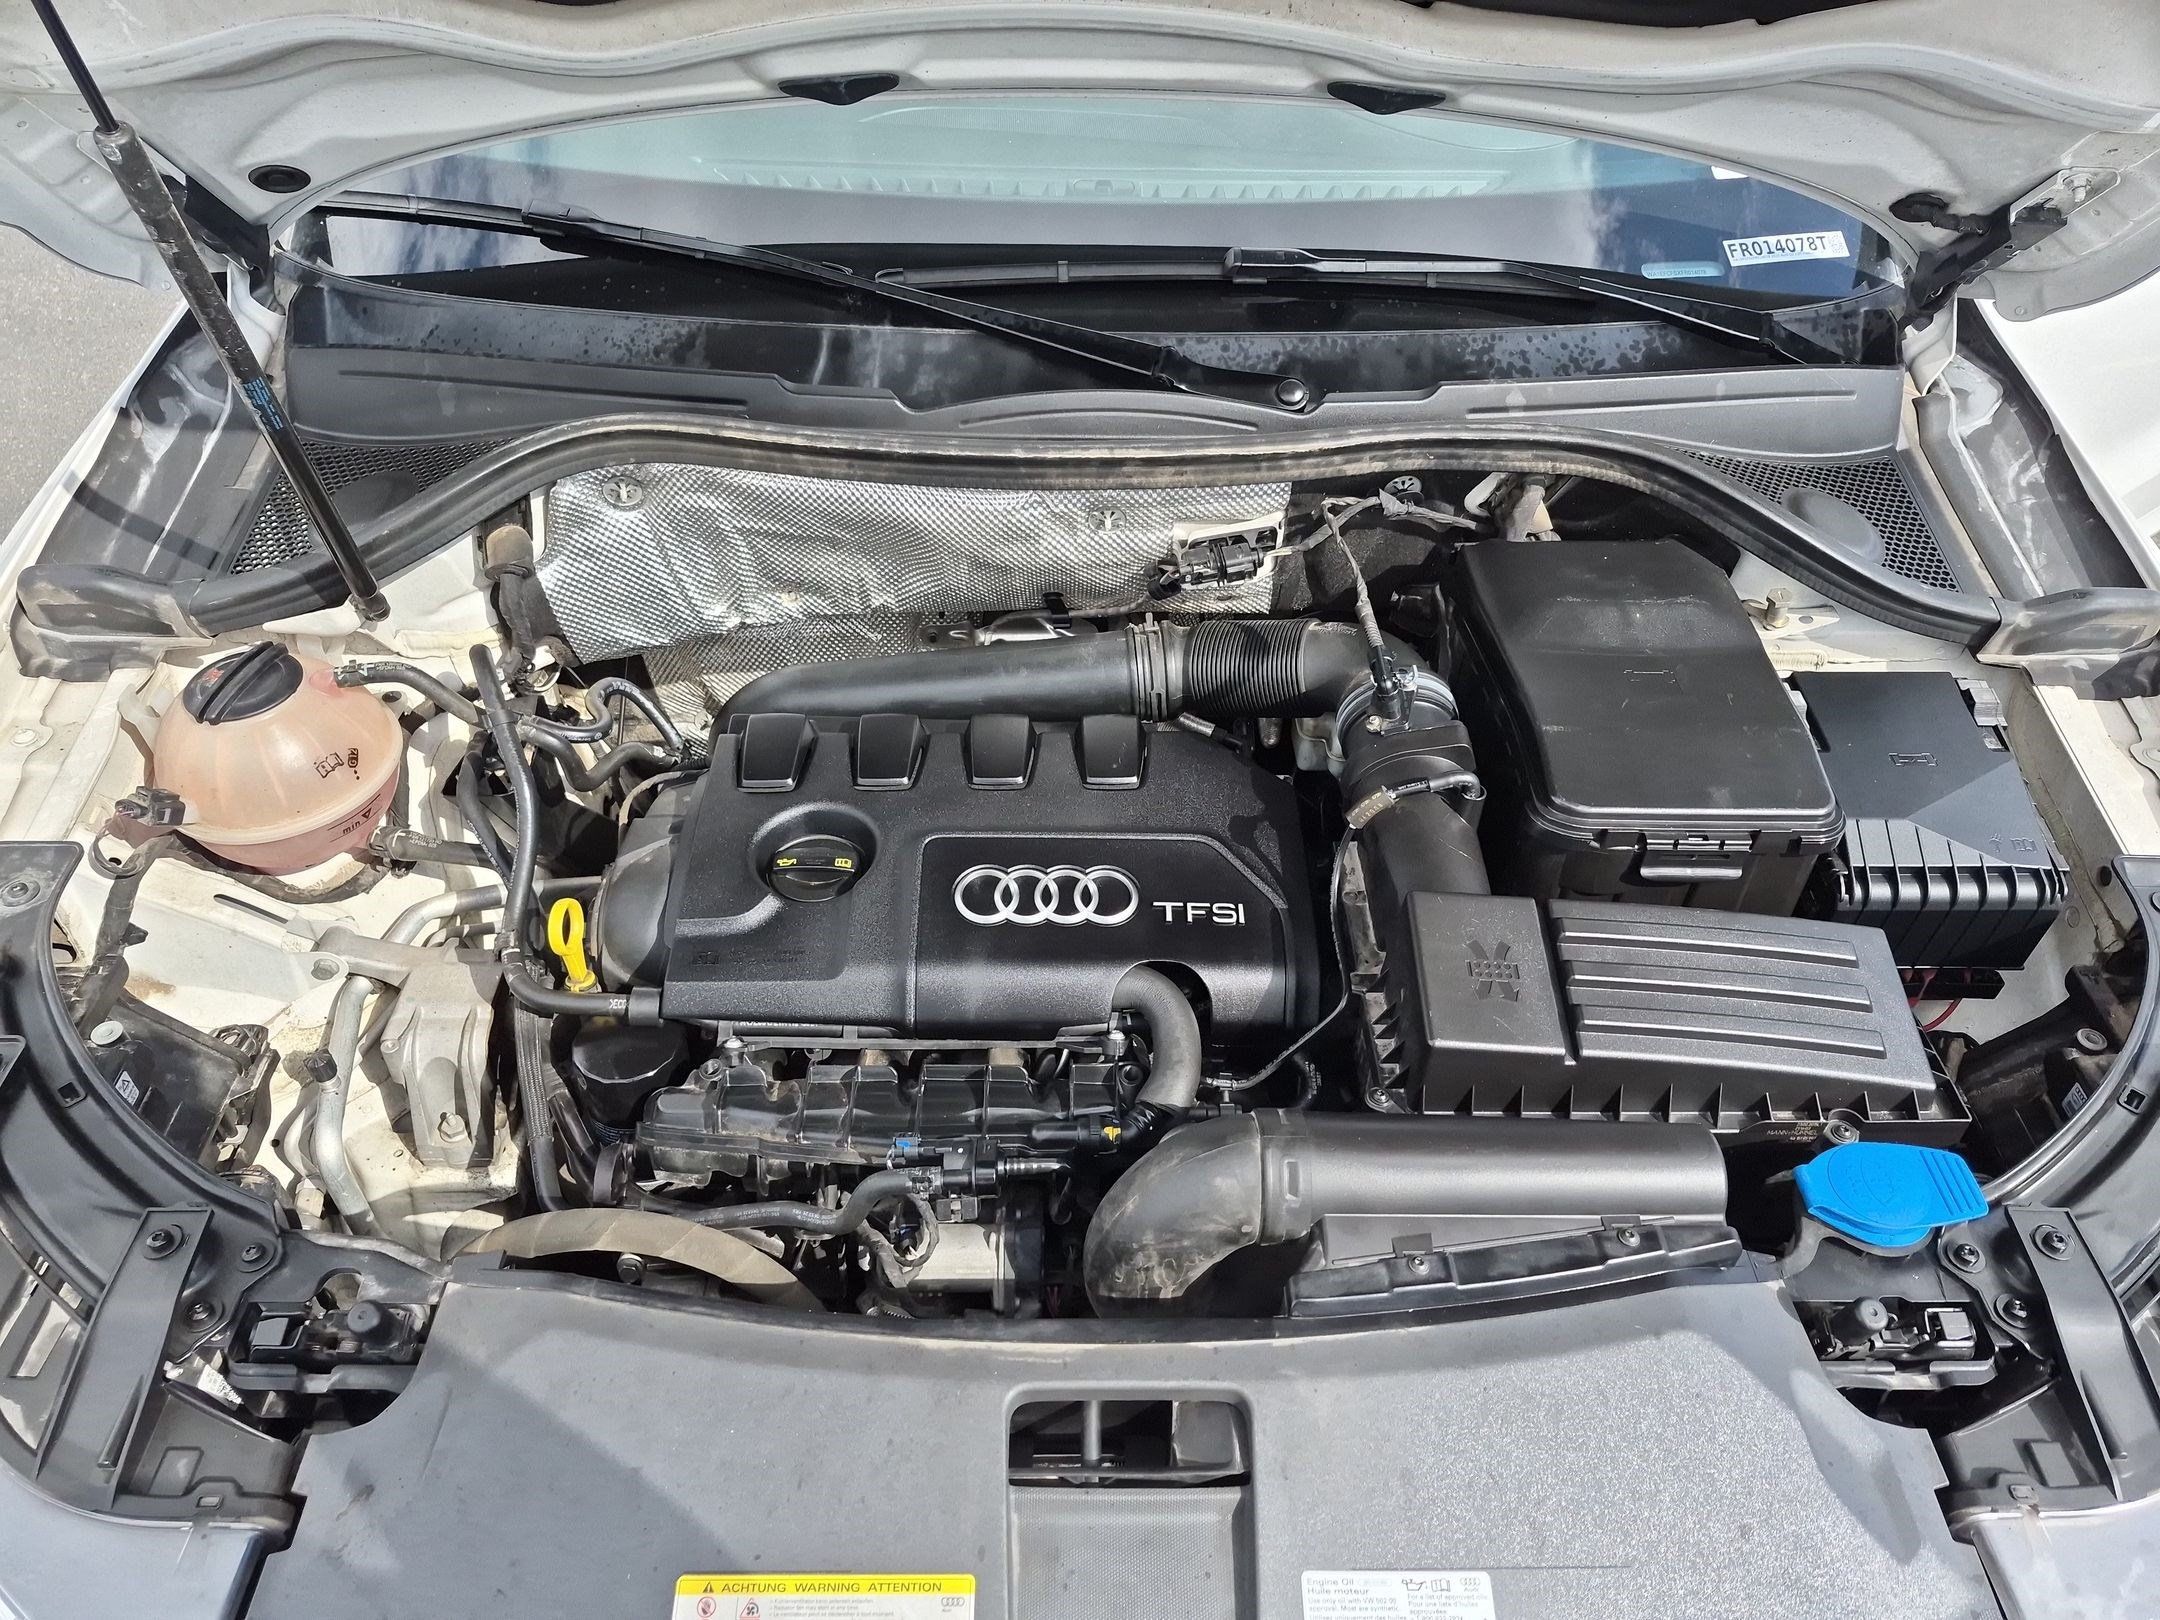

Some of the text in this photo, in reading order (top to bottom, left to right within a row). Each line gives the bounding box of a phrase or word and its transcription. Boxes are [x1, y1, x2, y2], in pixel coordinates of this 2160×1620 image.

[1727, 235, 1826, 258] FR014078T
[342, 821, 361, 835] min
[1153, 901, 1246, 926] TFSI
[721, 1582, 942, 1593] ACHTUNG WARNING ATTENTION
[1307, 1578, 1339, 1587] Engine
[1341, 1578, 1354, 1586] Oil
